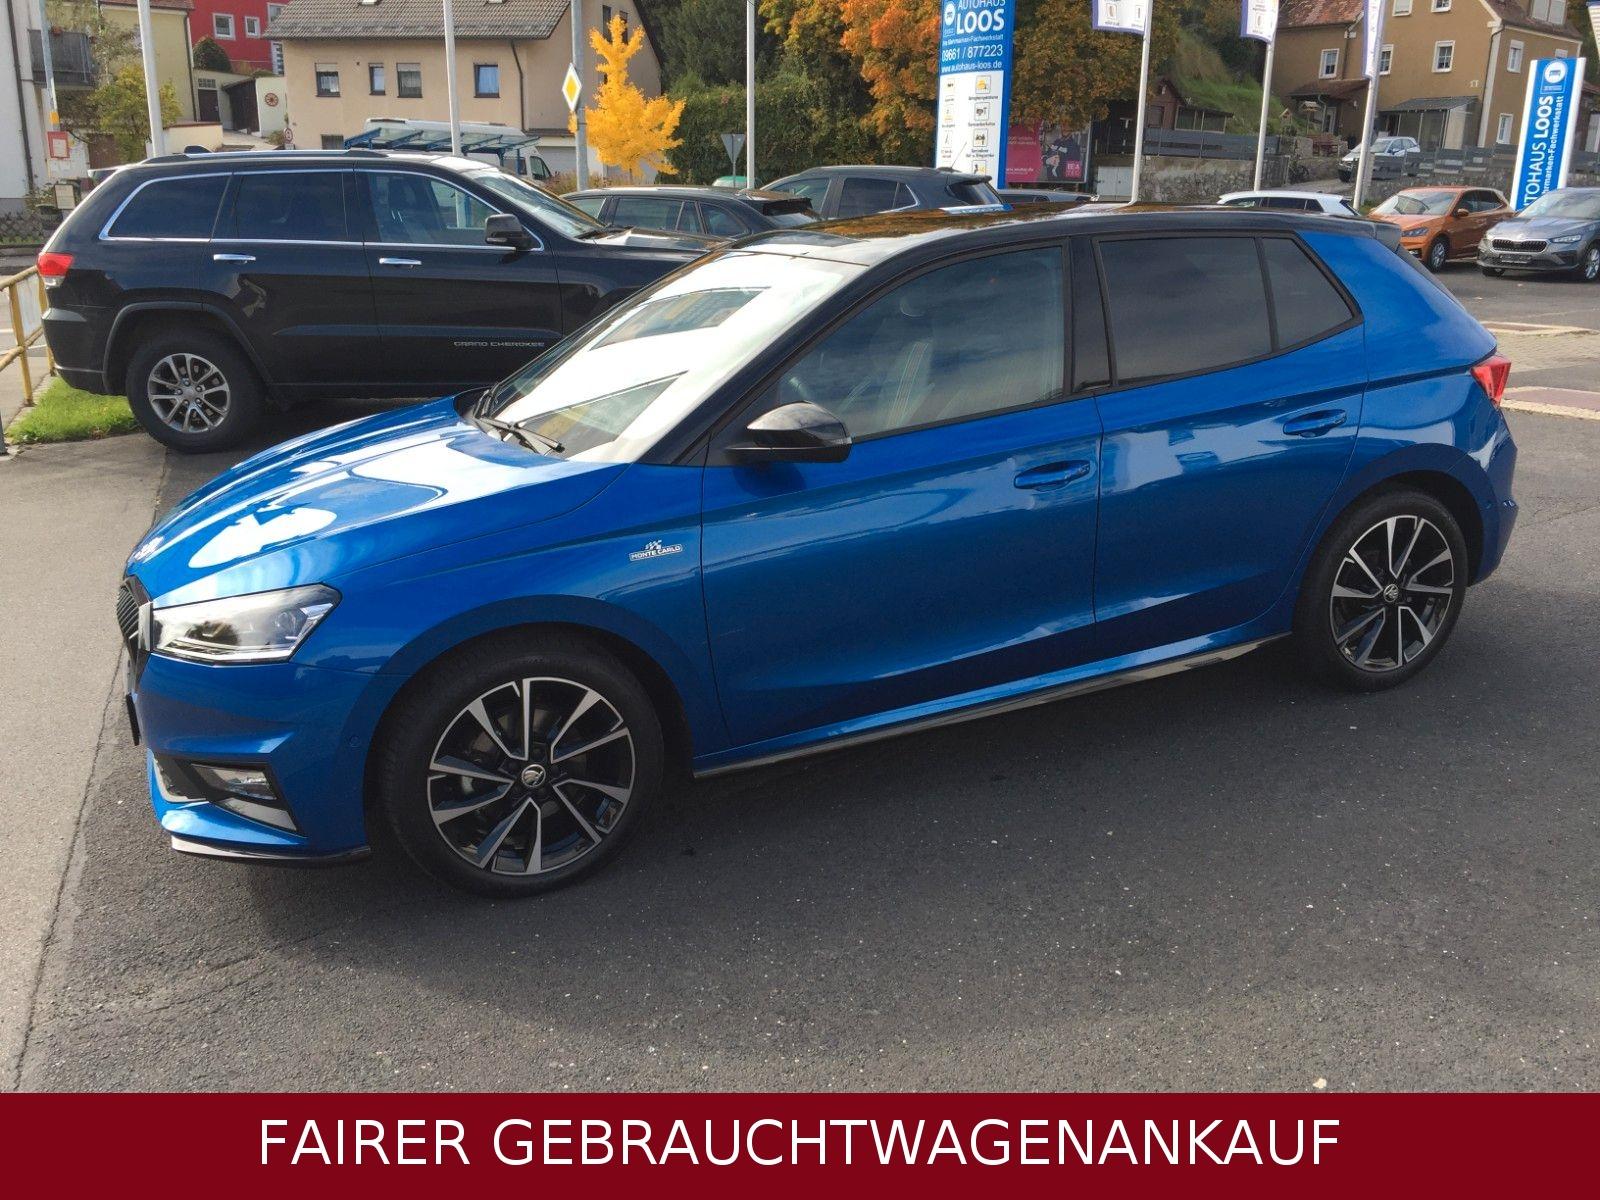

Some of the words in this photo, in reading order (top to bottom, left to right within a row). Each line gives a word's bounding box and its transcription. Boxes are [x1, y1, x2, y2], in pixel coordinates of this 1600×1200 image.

[957, 0, 1006, 10] AUTOHAUS
[956, 8, 1005, 35] LOOS
[967, 44, 1003, 59] 877223
[1533, 95, 1554, 139] LOOS
[1541, 95, 1565, 195] hrmarken-Fachwerkstatt
[1523, 141, 1547, 207] TOHAUS
[631, 550, 657, 560] MONTE
[657, 545, 681, 555] CARLO
